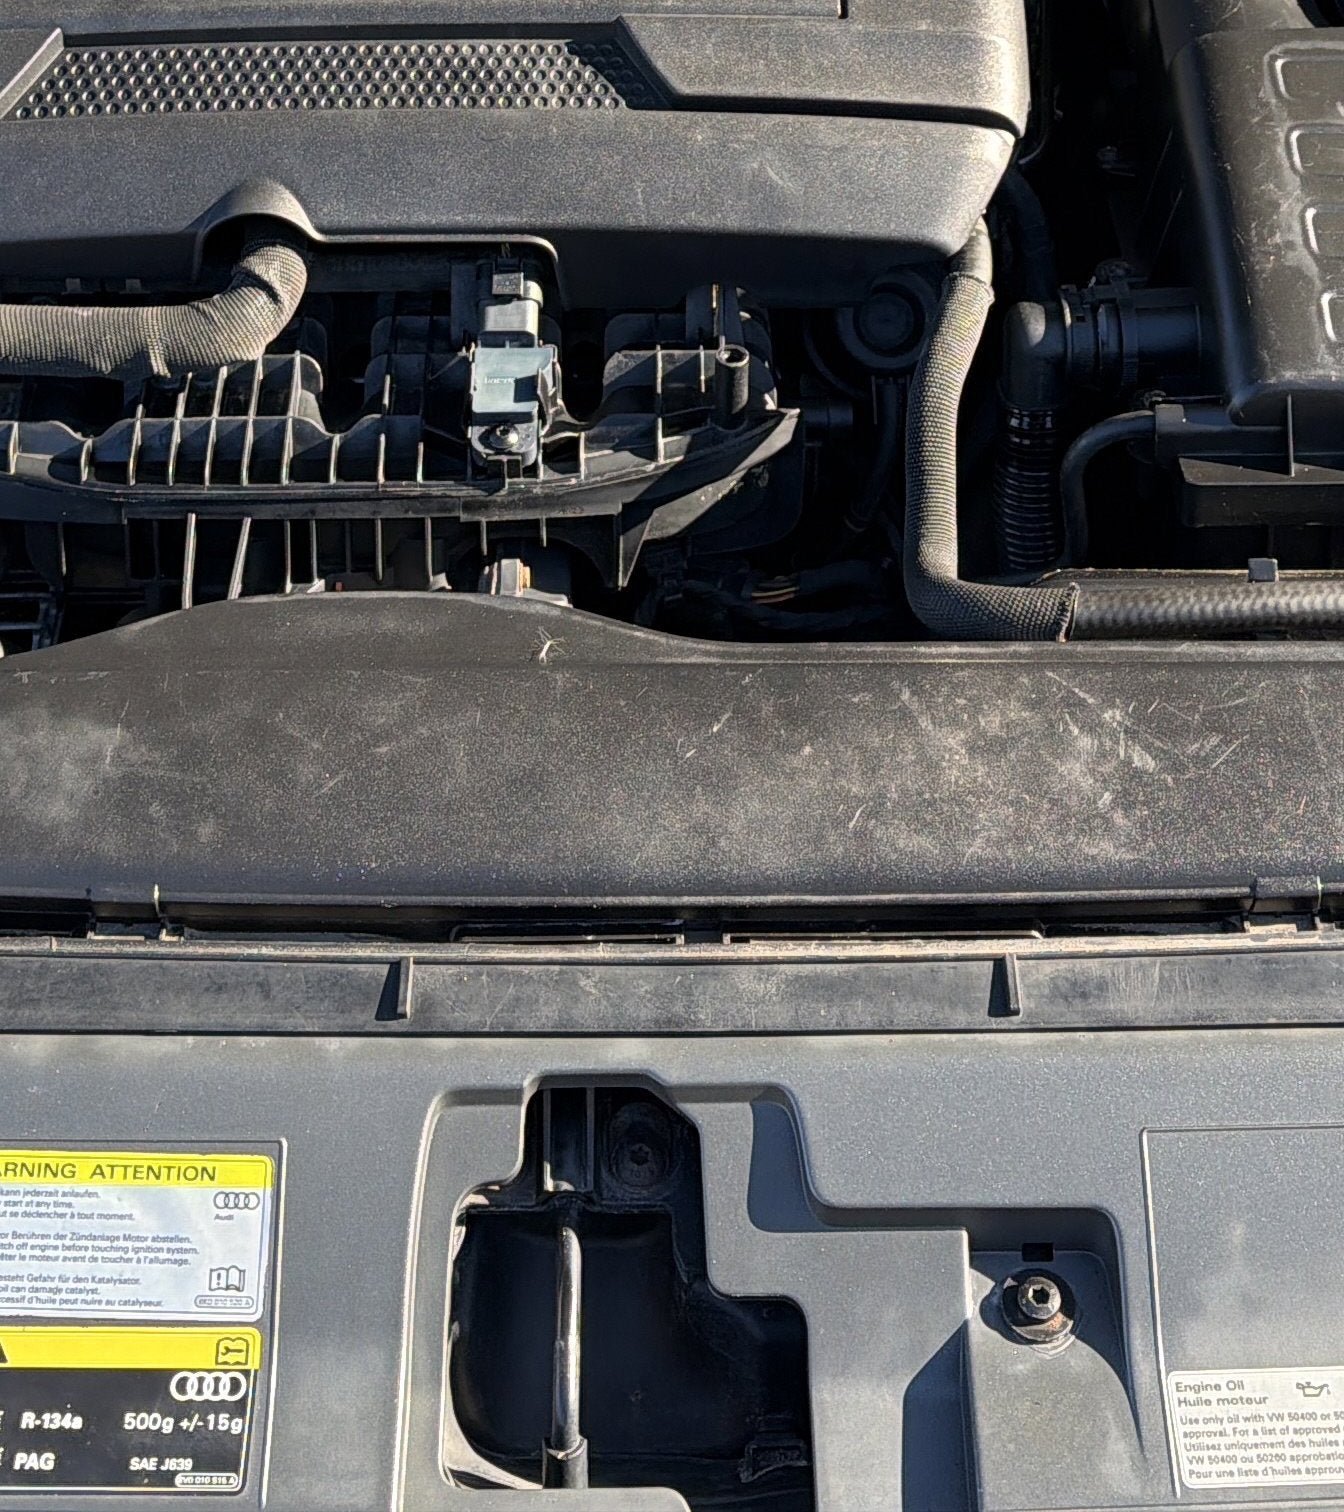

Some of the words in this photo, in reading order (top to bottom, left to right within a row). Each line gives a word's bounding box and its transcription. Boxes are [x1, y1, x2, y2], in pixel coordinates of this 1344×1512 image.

[90, 1163, 216, 1182] ATTENTION
[0, 1187, 21, 1197] kann
[22, 1188, 59, 1198] jederzeit
[61, 1189, 100, 1198] anlaufen.
[4, 1199, 22, 1207] start
[25, 1200, 33, 1208] at
[35, 1201, 51, 1209] any
[53, 1200, 75, 1208] time.
[77, 1211, 94, 1219] tout
[53, 1232, 67, 1240] der
[123, 1233, 149, 1242] Motor
[151, 1234, 192, 1243] abstellen.
[16, 1242, 28, 1250] off
[30, 1243, 59, 1253] engine
[62, 1243, 89, 1252] before
[91, 1244, 129, 1254] touching
[131, 1244, 164, 1254] ignition
[166, 1246, 200, 1255] system.
[19, 1253, 26, 1261] le
[29, 1254, 60, 1262] moteur
[62, 1255, 86, 1263] avant
[88, 1255, 98, 1263] de
[101, 1255, 134, 1264] toucher
[27, 1273, 56, 1283] Gefahr
[58, 1274, 70, 1283] für
[72, 1274, 89, 1283] den
[28, 1286, 63, 1295] damage
[65, 1286, 100, 1295] catalyst.
[59, 1297, 78, 1306] peut
[80, 1298, 103, 1306] nuire
[1175, 1381, 1222, 1394] Engine
[1226, 1380, 1245, 1391] Oil
[1177, 1396, 1212, 1408] Huile
[1216, 1395, 1269, 1406] moteur
[20, 1412, 83, 1430] R-134a
[123, 1413, 174, 1434] 500g
[1180, 1415, 1200, 1425] Use
[1202, 1414, 1224, 1426] only
[1227, 1413, 1240, 1423] oil
[1242, 1413, 1265, 1423] with
[1266, 1412, 1285, 1422] VW
[1287, 1411, 1318, 1421] 50400
[1320, 1413, 1331, 1421] or
[1183, 1428, 1231, 1440] approval.
[1232, 1427, 1249, 1437] For
[1252, 1428, 1259, 1436] a
[1261, 1426, 1277, 1436] list
[1279, 1425, 1290, 1435] of
[1292, 1424, 1341, 1436] approved
[1184, 1442, 1222, 1452] Utilisez
[1224, 1440, 1285, 1451] uniquement
[1288, 1439, 1306, 1448] des
[1308, 1437, 1340, 1448] huiles
[13, 1453, 56, 1471] PAG
[129, 1457, 158, 1471] SAE
[160, 1457, 193, 1471] J639
[1186, 1455, 1205, 1465] VW
[1188, 1469, 1213, 1479] Pour
[1216, 1469, 1235, 1478] une
[1237, 1467, 1260, 1477] liste
